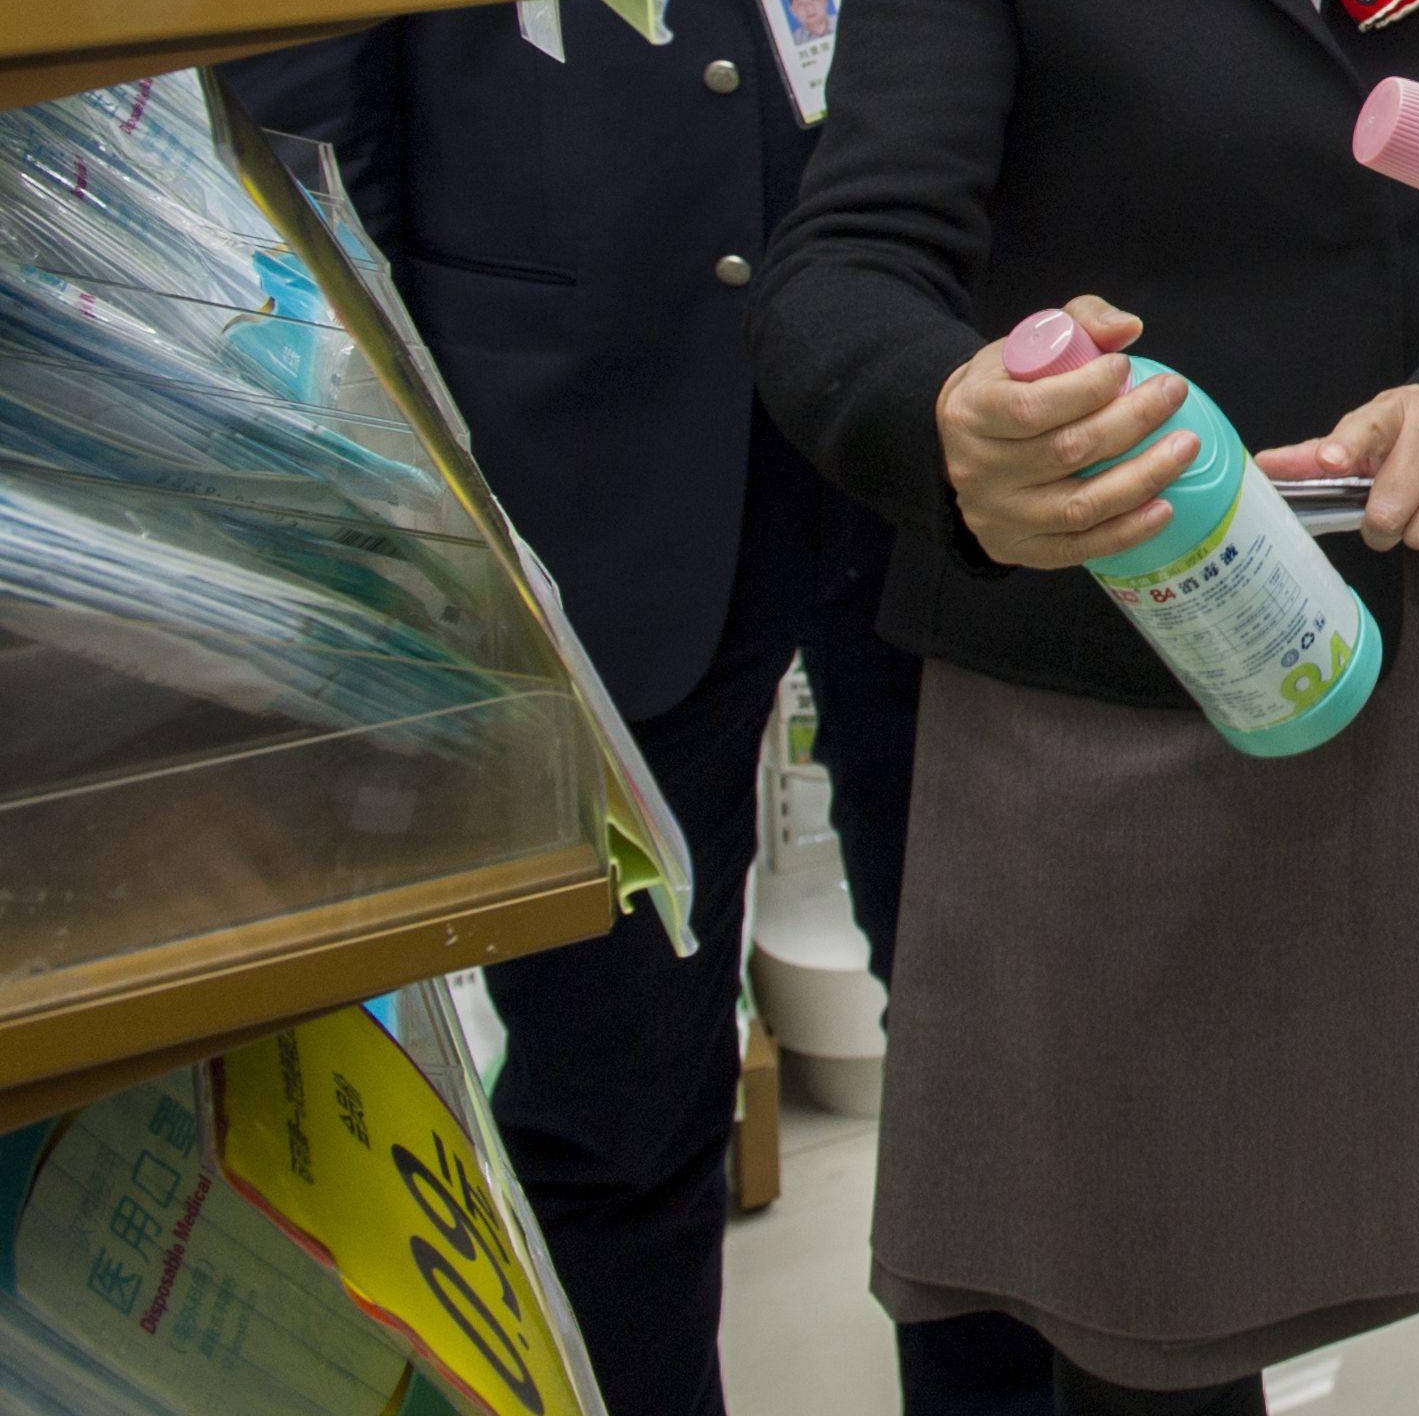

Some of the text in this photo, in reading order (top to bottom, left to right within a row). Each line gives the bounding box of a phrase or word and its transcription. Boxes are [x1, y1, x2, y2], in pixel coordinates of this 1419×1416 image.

[1149, 542, 1240, 605] 84 消毒液
[87, 1094, 198, 1317] 医用口罩
[140, 1172, 213, 1337] Disposable Medical
